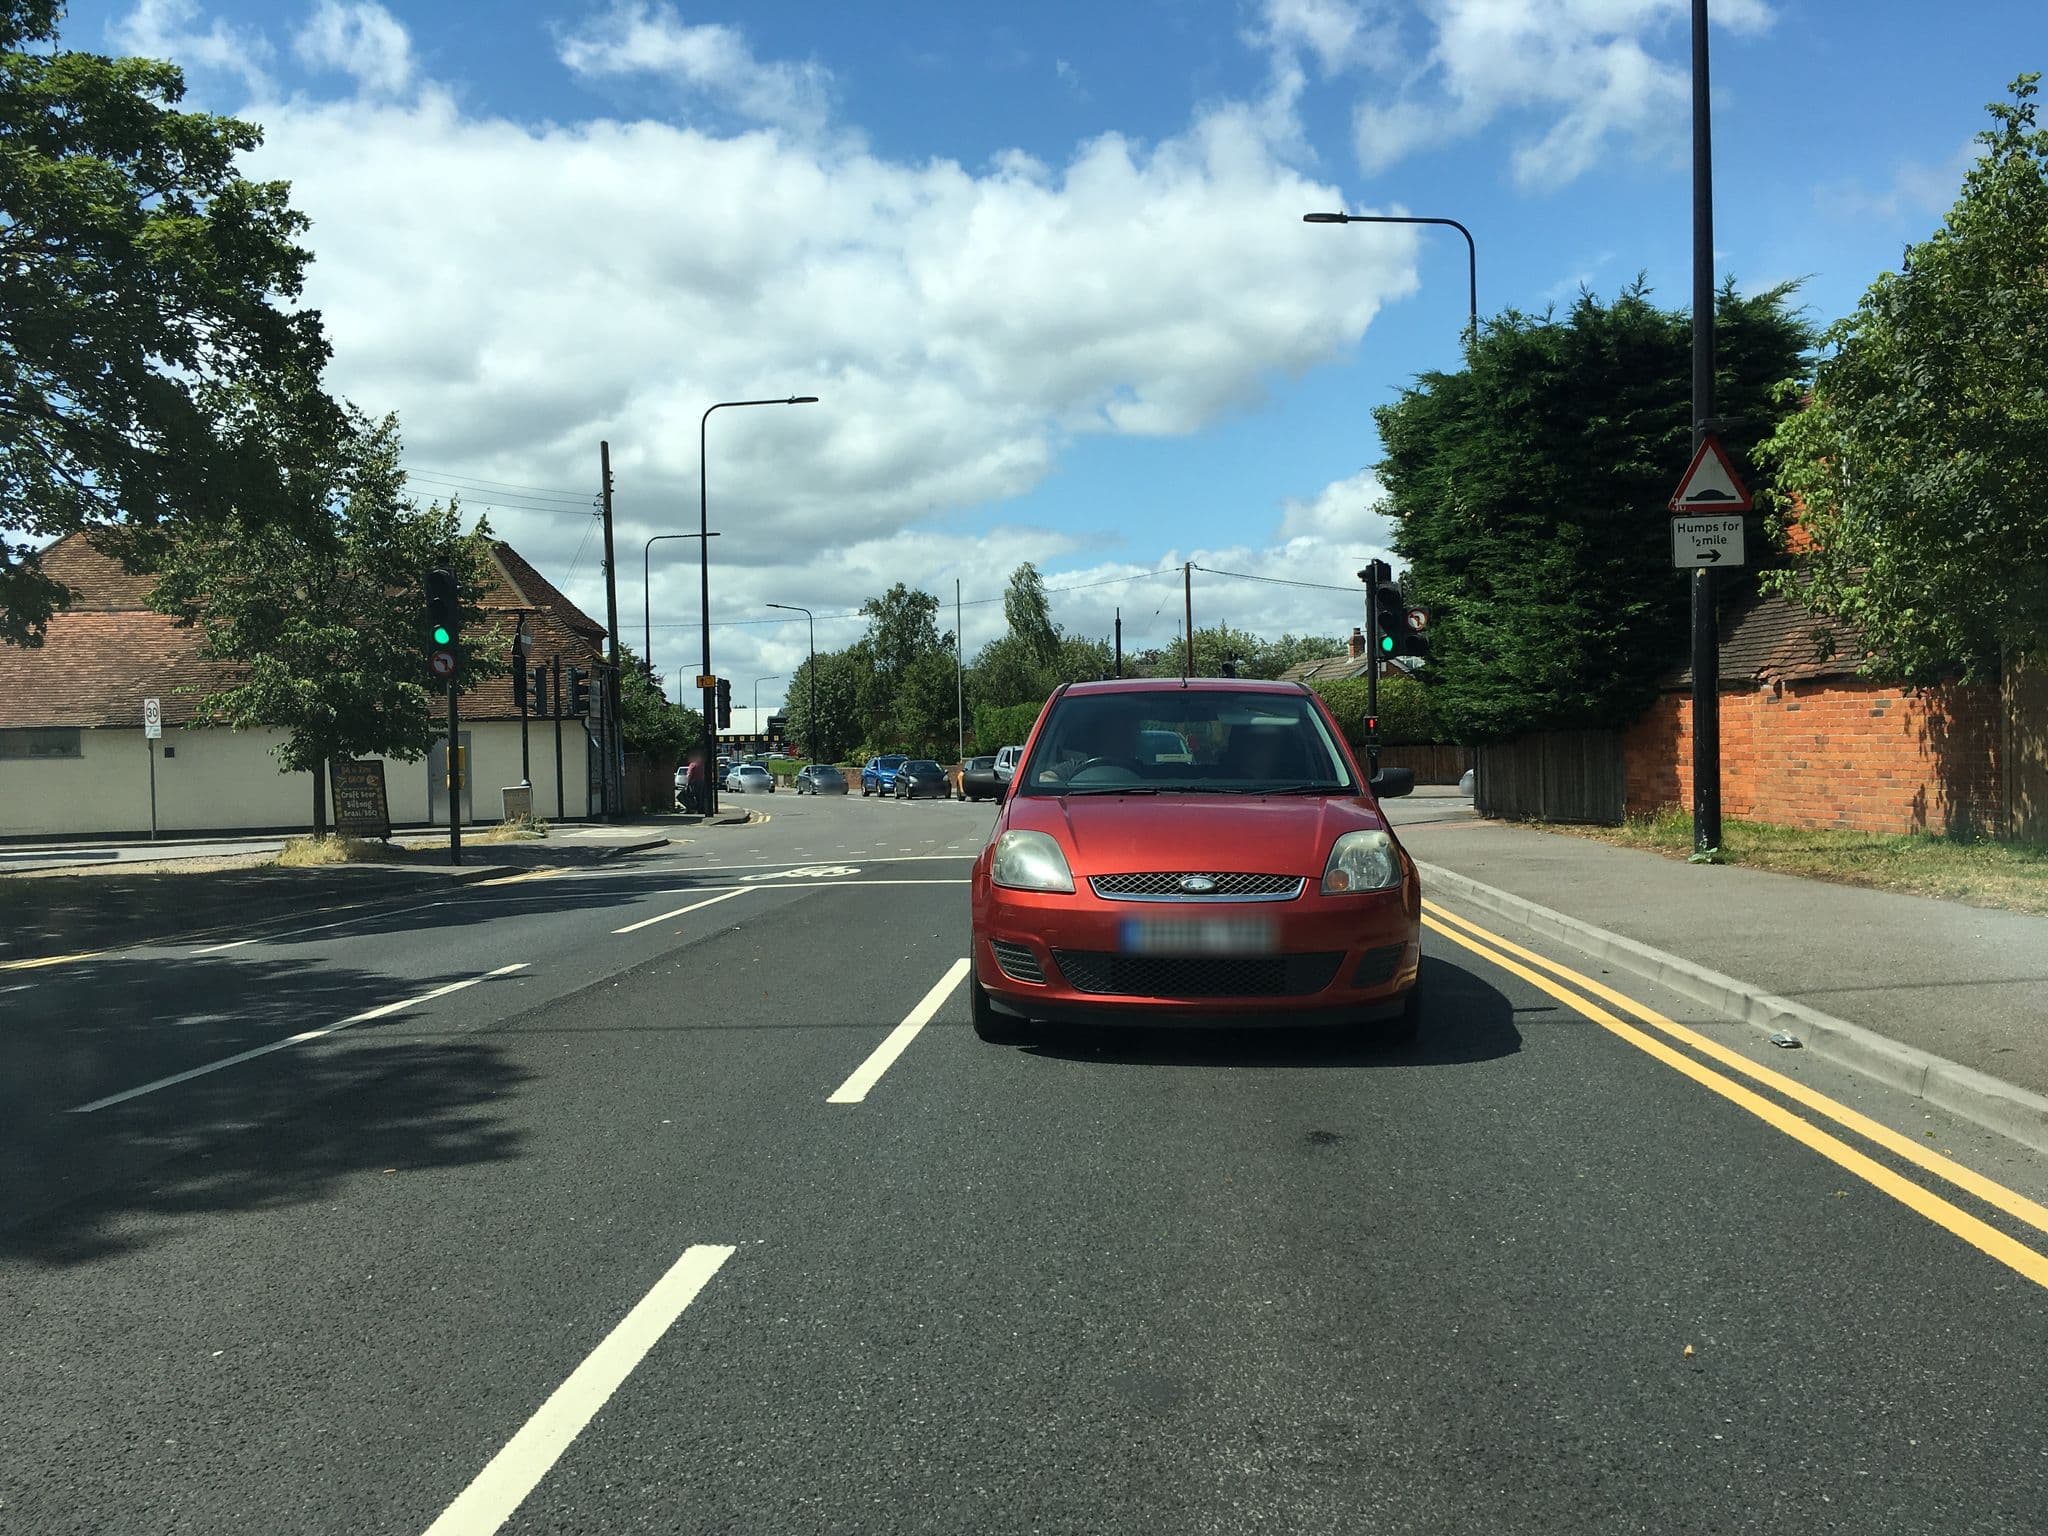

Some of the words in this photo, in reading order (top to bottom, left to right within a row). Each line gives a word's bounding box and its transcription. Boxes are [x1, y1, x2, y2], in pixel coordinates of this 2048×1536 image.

[1677, 522, 1720, 534] Humps
[1723, 521, 1740, 531] for
[147, 707, 157, 718] 30
[341, 791, 359, 799] Craft
